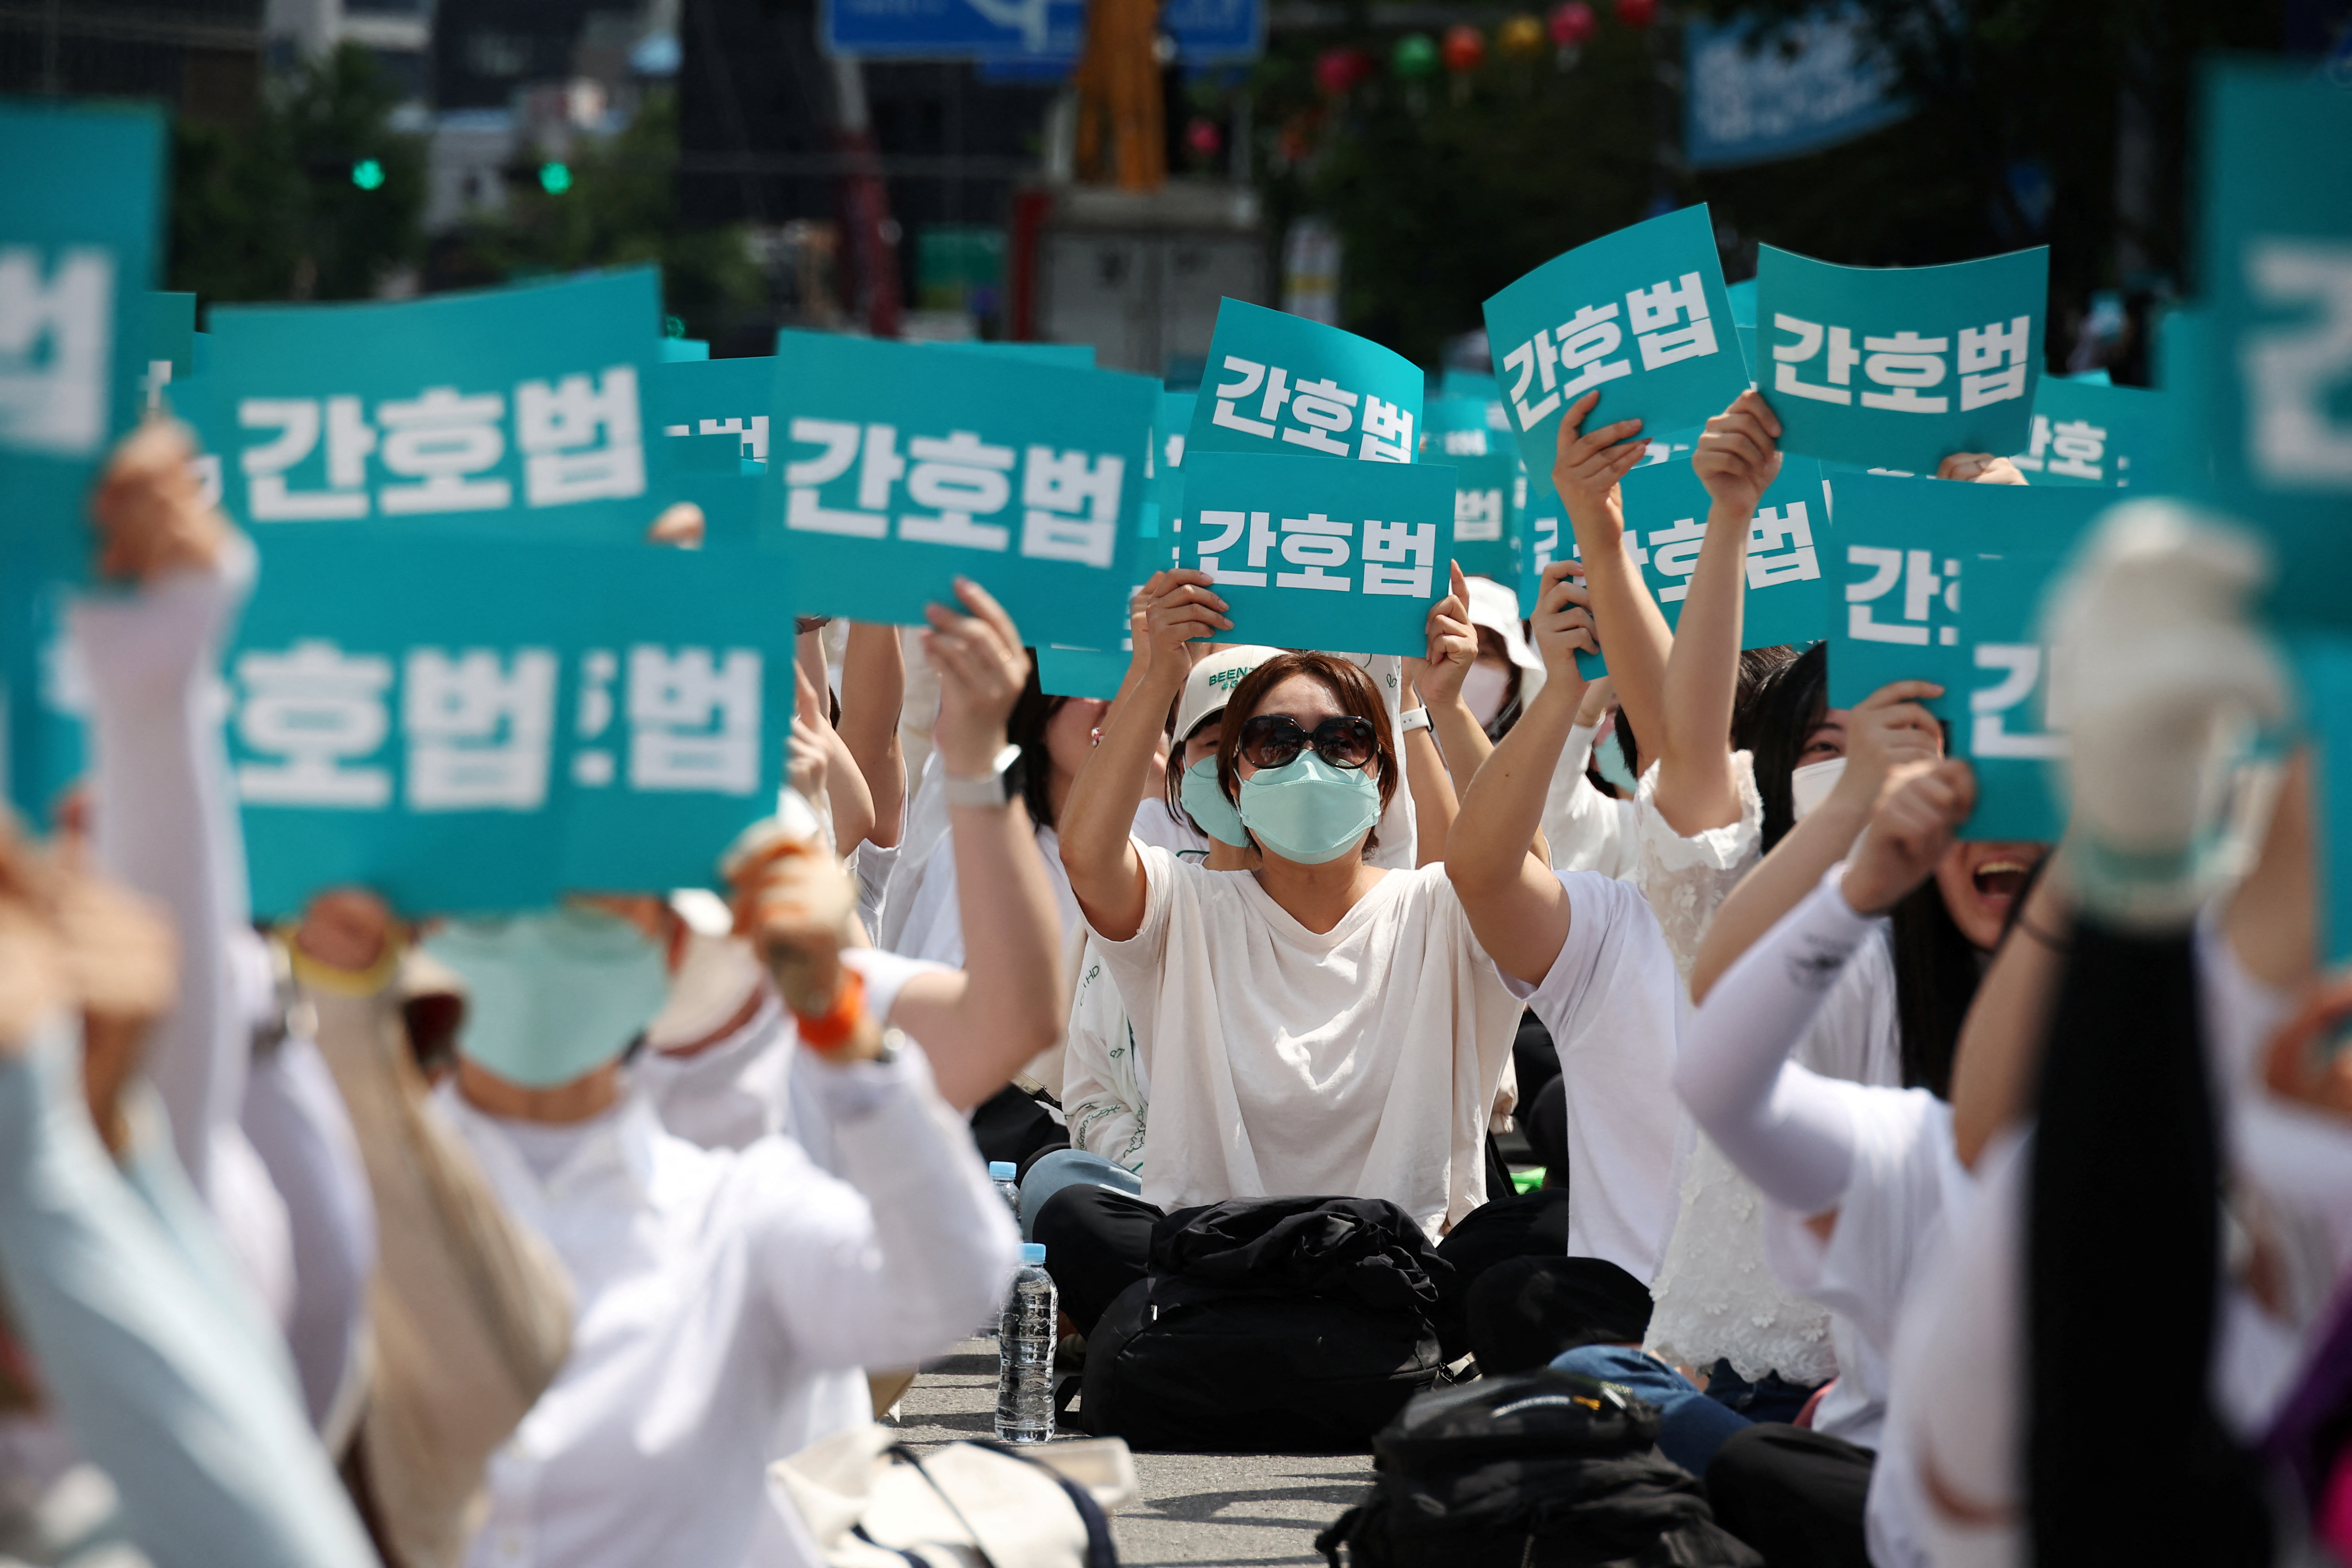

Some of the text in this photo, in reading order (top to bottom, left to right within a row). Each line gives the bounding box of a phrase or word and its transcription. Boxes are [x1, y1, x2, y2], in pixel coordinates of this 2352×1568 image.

[1212, 355, 1414, 464] 간호법
[1504, 270, 1719, 433] 간호법
[1773, 313, 2030, 414] 간호법
[238, 365, 648, 521] 간호법
[785, 417, 1125, 568] 간호법
[1197, 510, 1436, 599] 간호법
